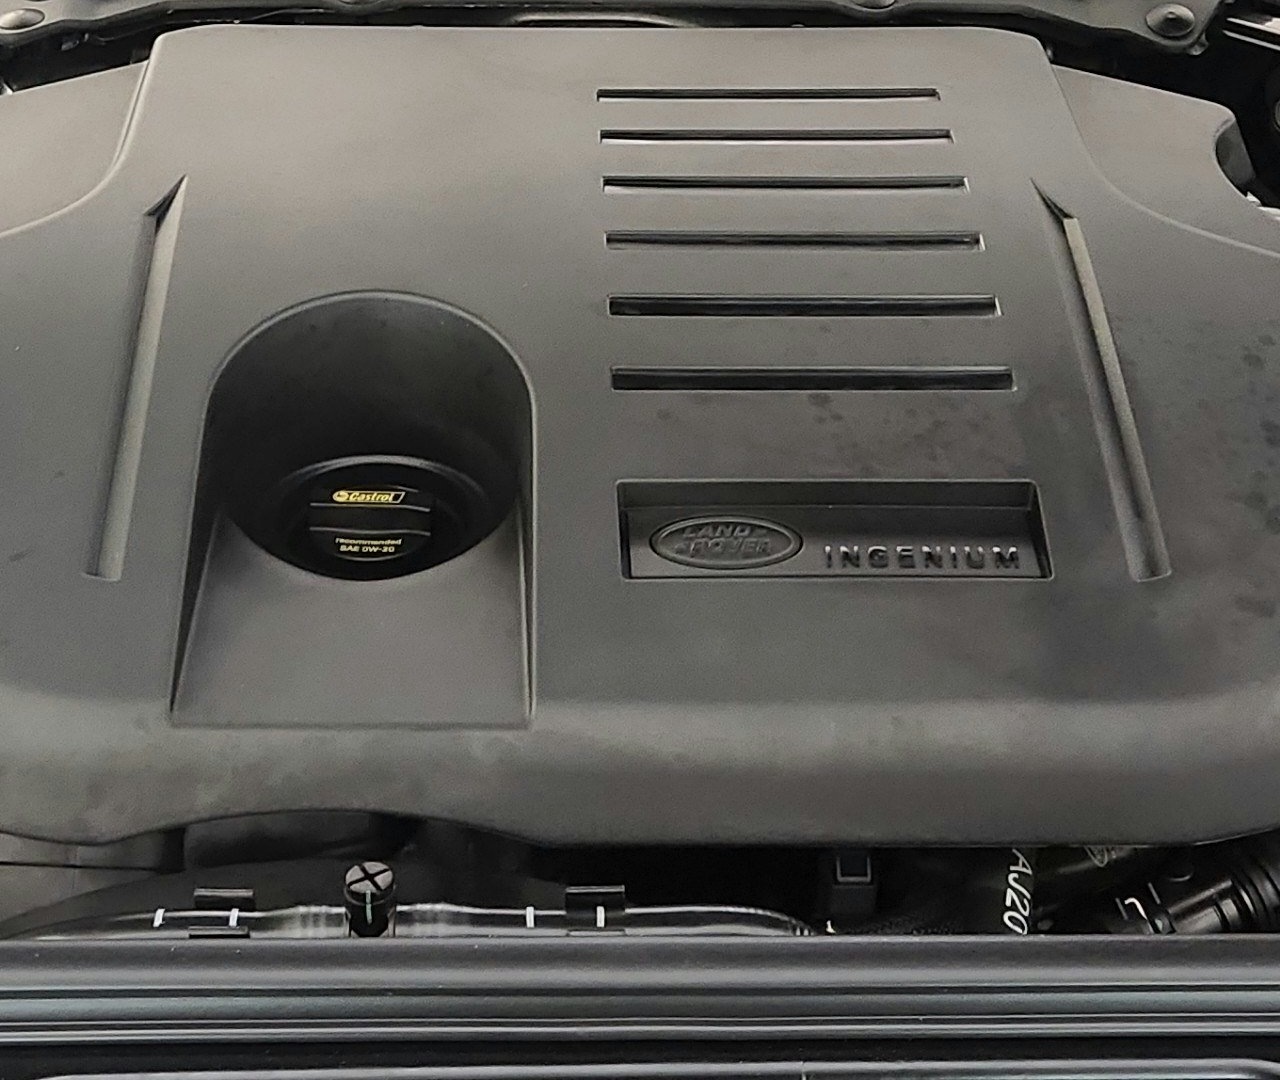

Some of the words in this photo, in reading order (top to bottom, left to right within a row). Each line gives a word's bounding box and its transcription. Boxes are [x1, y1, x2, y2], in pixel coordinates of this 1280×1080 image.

[349, 490, 394, 502] Castrol
[683, 524, 751, 538] LAND
[335, 537, 402, 546] recommended
[824, 545, 1019, 570] INGENIUM
